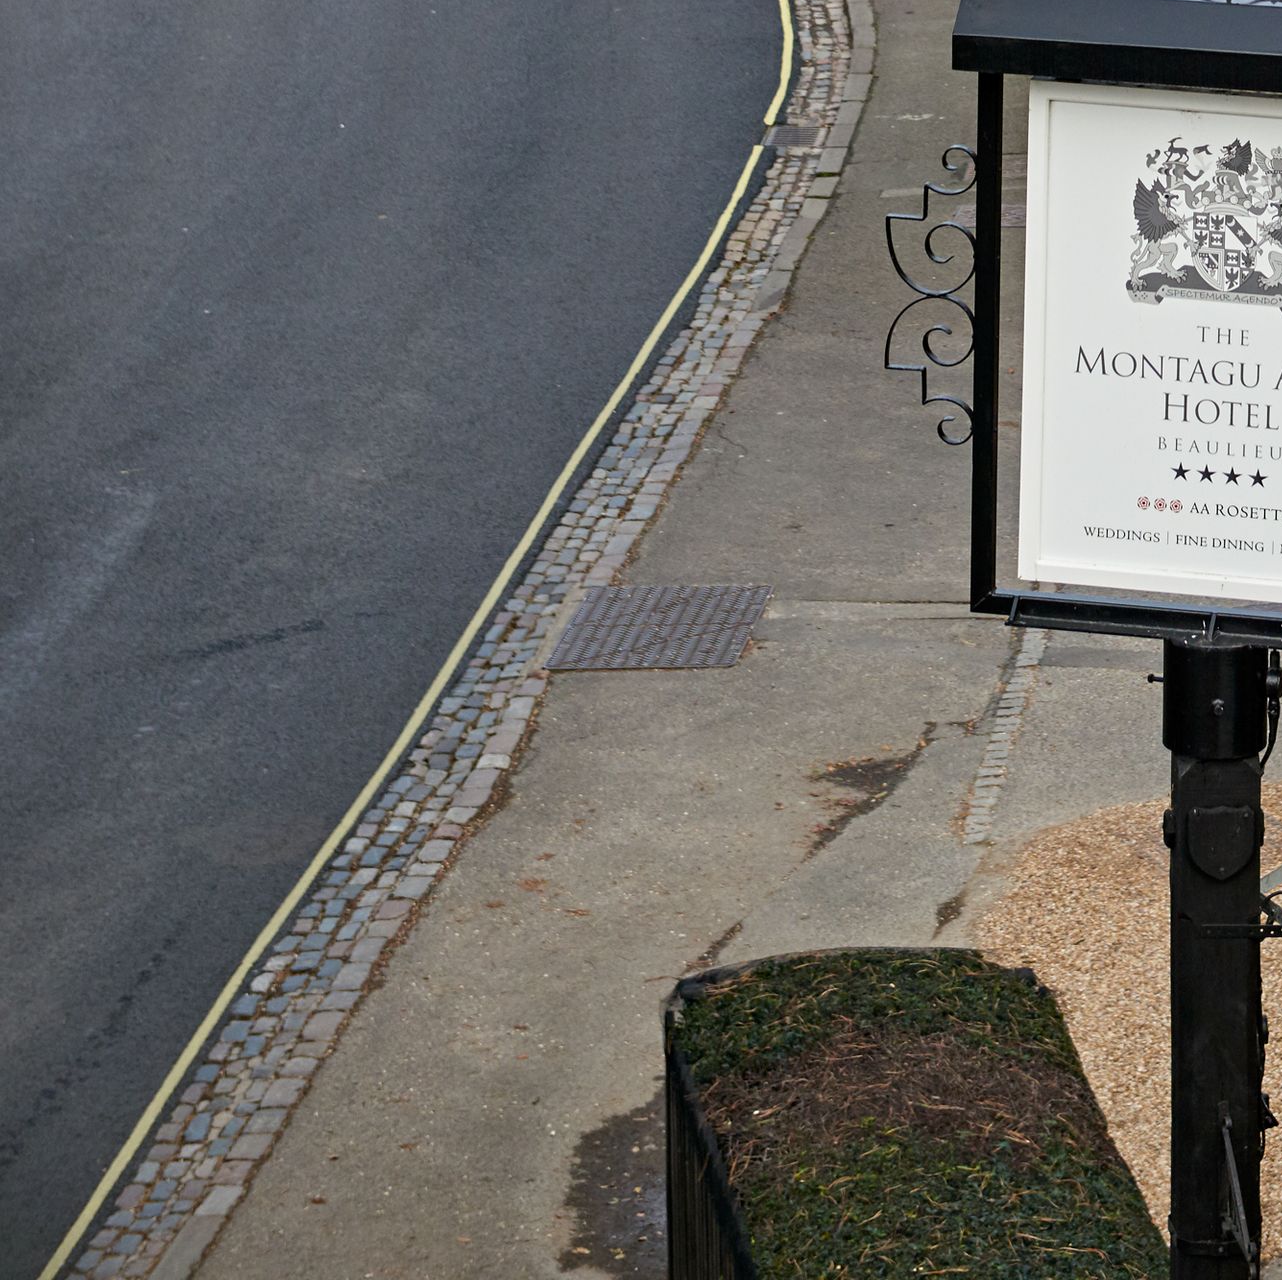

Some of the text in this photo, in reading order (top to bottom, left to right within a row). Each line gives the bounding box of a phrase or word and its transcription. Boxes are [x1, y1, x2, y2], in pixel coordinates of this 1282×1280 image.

[1165, 288, 1280, 305] SPECTEMUR AGENDO
[1196, 325, 1251, 346] THE
[1074, 344, 1262, 389] MONTAGU
[1162, 392, 1280, 431] HOTEL
[1157, 436, 1282, 461] BEAULIEU
[1189, 501, 1211, 516] AA
[1083, 525, 1161, 543] WEDDINGS
[1175, 534, 1208, 548] FINE
[1211, 537, 1266, 552] DINING
